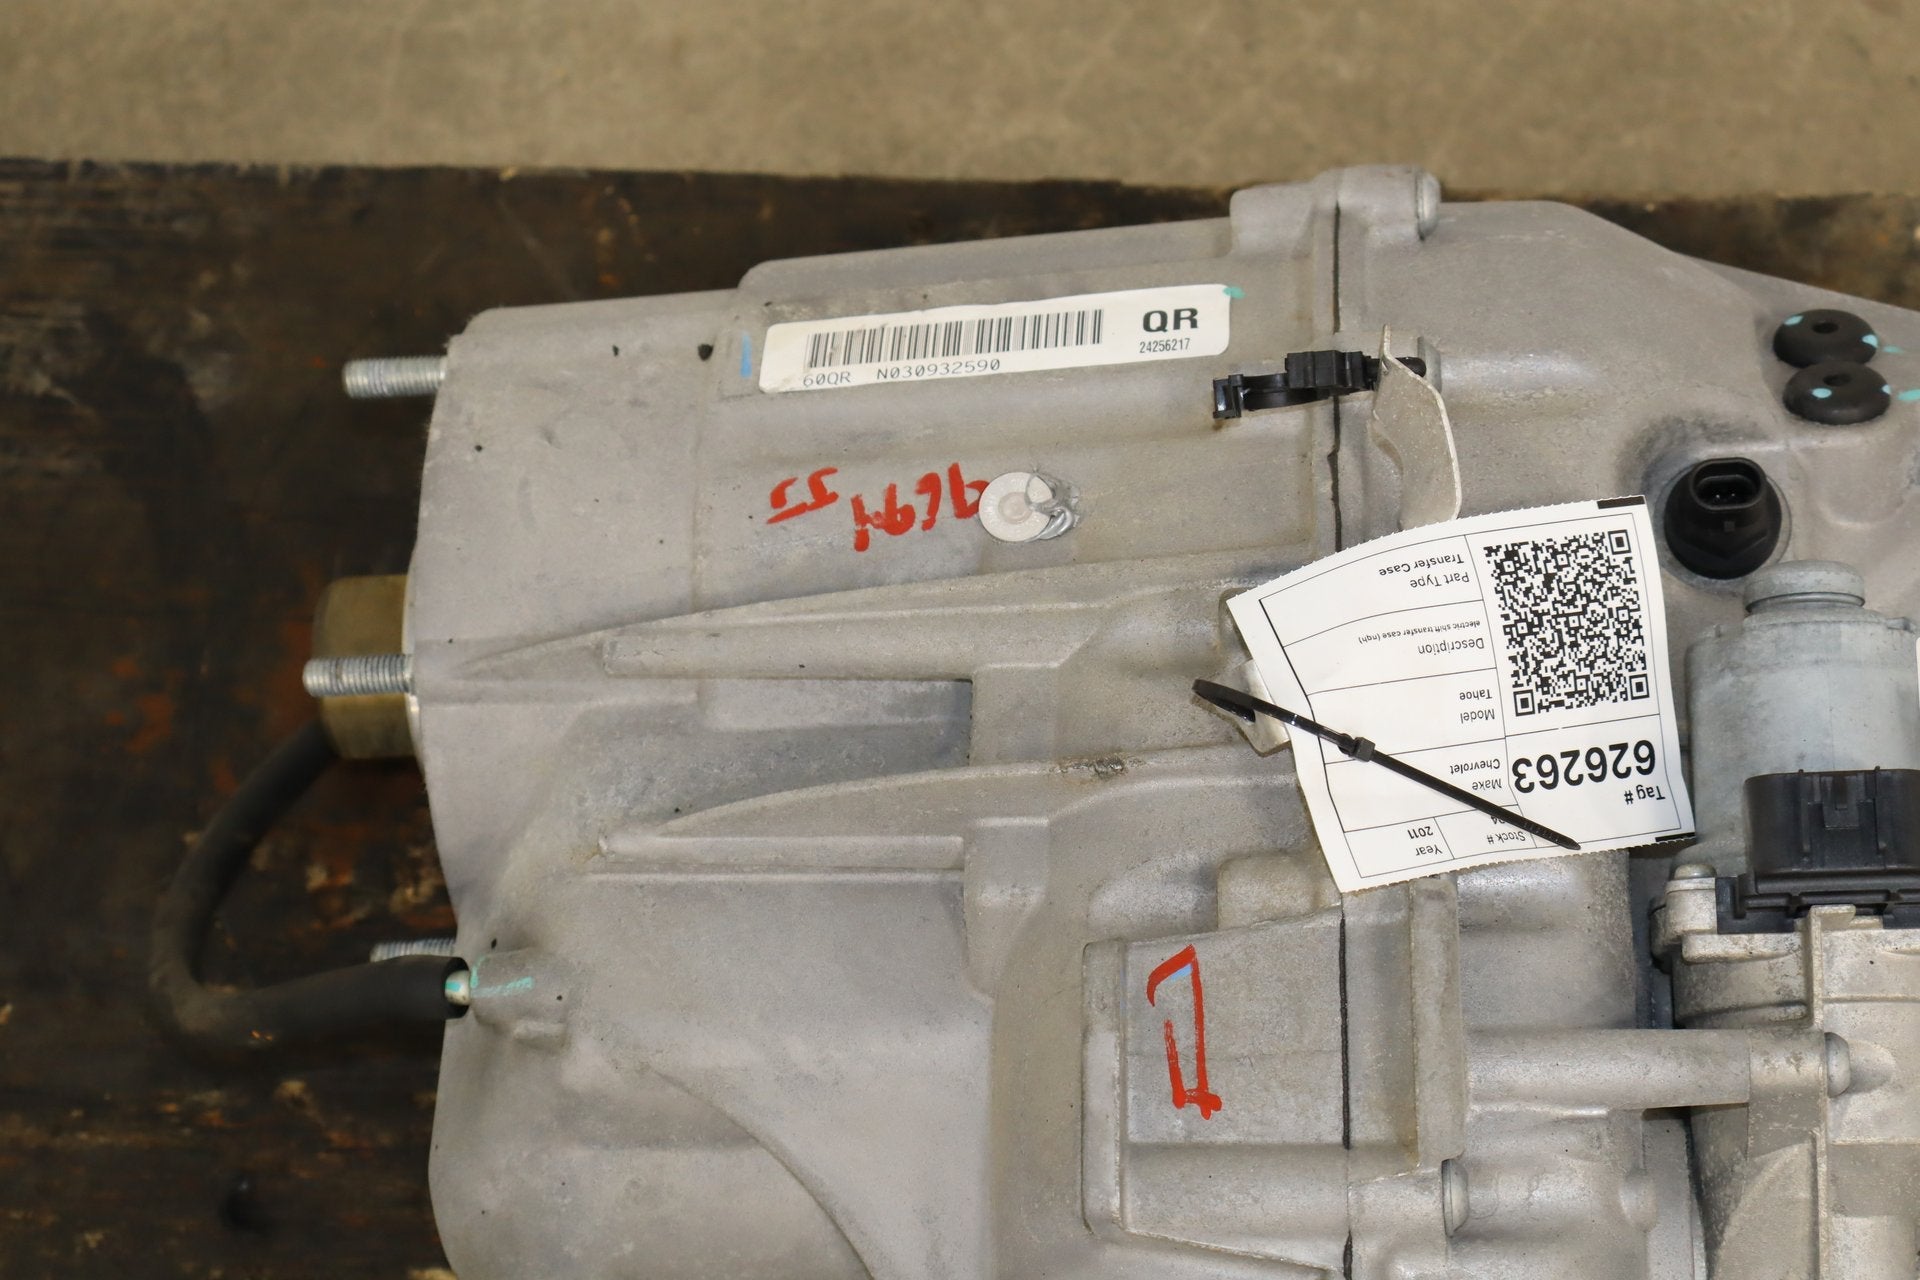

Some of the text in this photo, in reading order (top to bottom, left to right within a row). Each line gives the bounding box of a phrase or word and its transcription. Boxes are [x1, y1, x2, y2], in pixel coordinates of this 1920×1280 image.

[1142, 308, 1199, 333] QR
[1139, 338, 1191, 354] 24256217
[803, 359, 1000, 387] 60QR N030932590
[1378, 553, 1464, 578] Transfer Case
[1409, 572, 1470, 590] Part Type
[1403, 626, 1433, 636] transfer
[1434, 624, 1451, 632] shift
[1452, 620, 1480, 630] electric
[1382, 630, 1401, 638] case
[1417, 637, 1485, 656] Description
[1459, 689, 1492, 703] Tahoe
[1460, 708, 1495, 724] Model
[1449, 758, 1501, 776] Chevrolet
[1511, 740, 1656, 794] 626263
[1472, 779, 1502, 792] Make
[1623, 785, 1666, 804] Tag #
[1407, 826, 1433, 839] 2011
[1486, 831, 1526, 844] Stock #
[1415, 844, 1442, 857] Year
